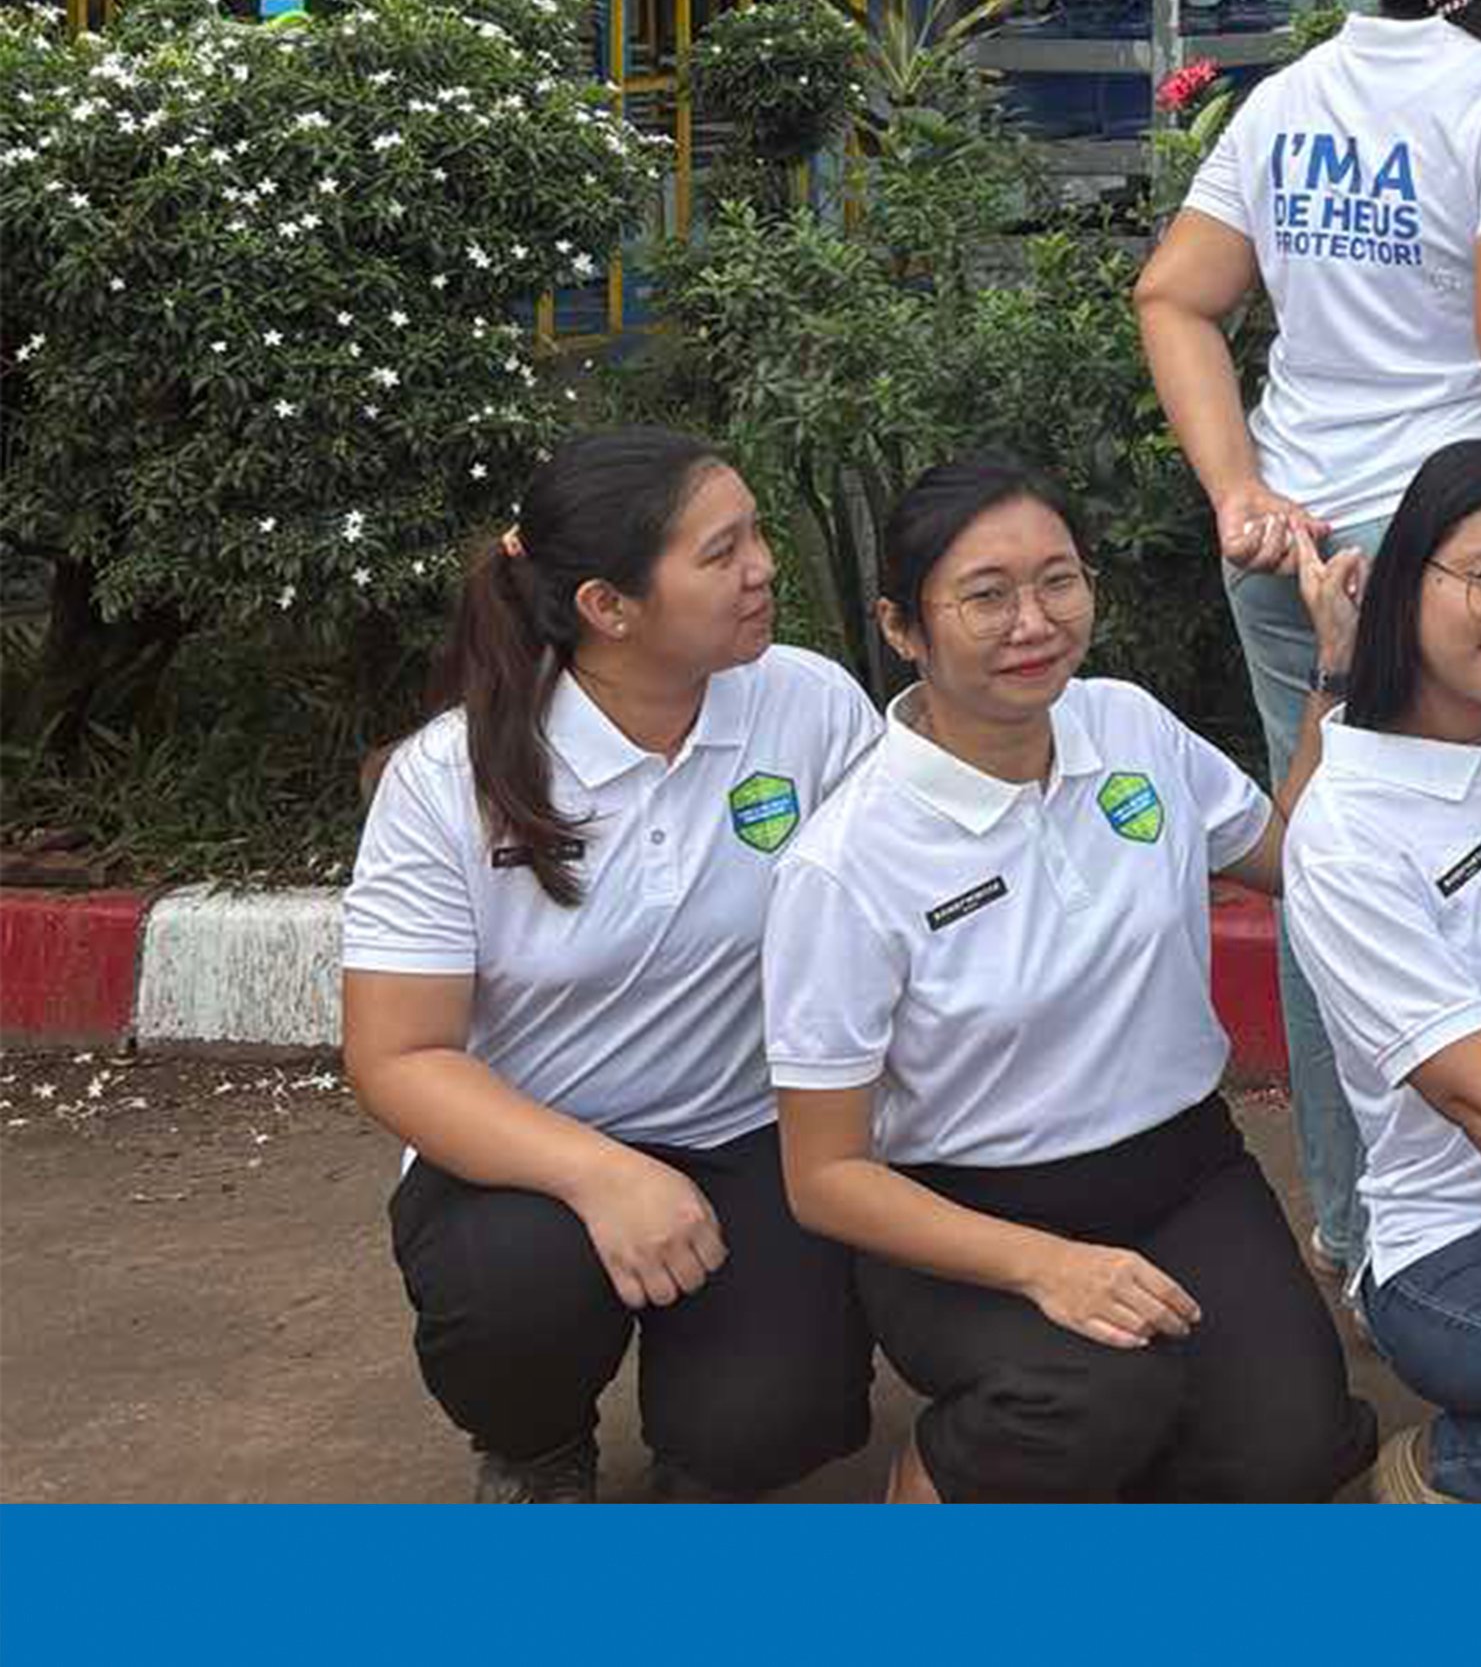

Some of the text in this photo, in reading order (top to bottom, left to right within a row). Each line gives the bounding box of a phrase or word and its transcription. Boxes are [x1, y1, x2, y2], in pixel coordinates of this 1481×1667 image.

[1271, 133, 1417, 201] I'M A
[1274, 194, 1419, 240] DE HEUS
